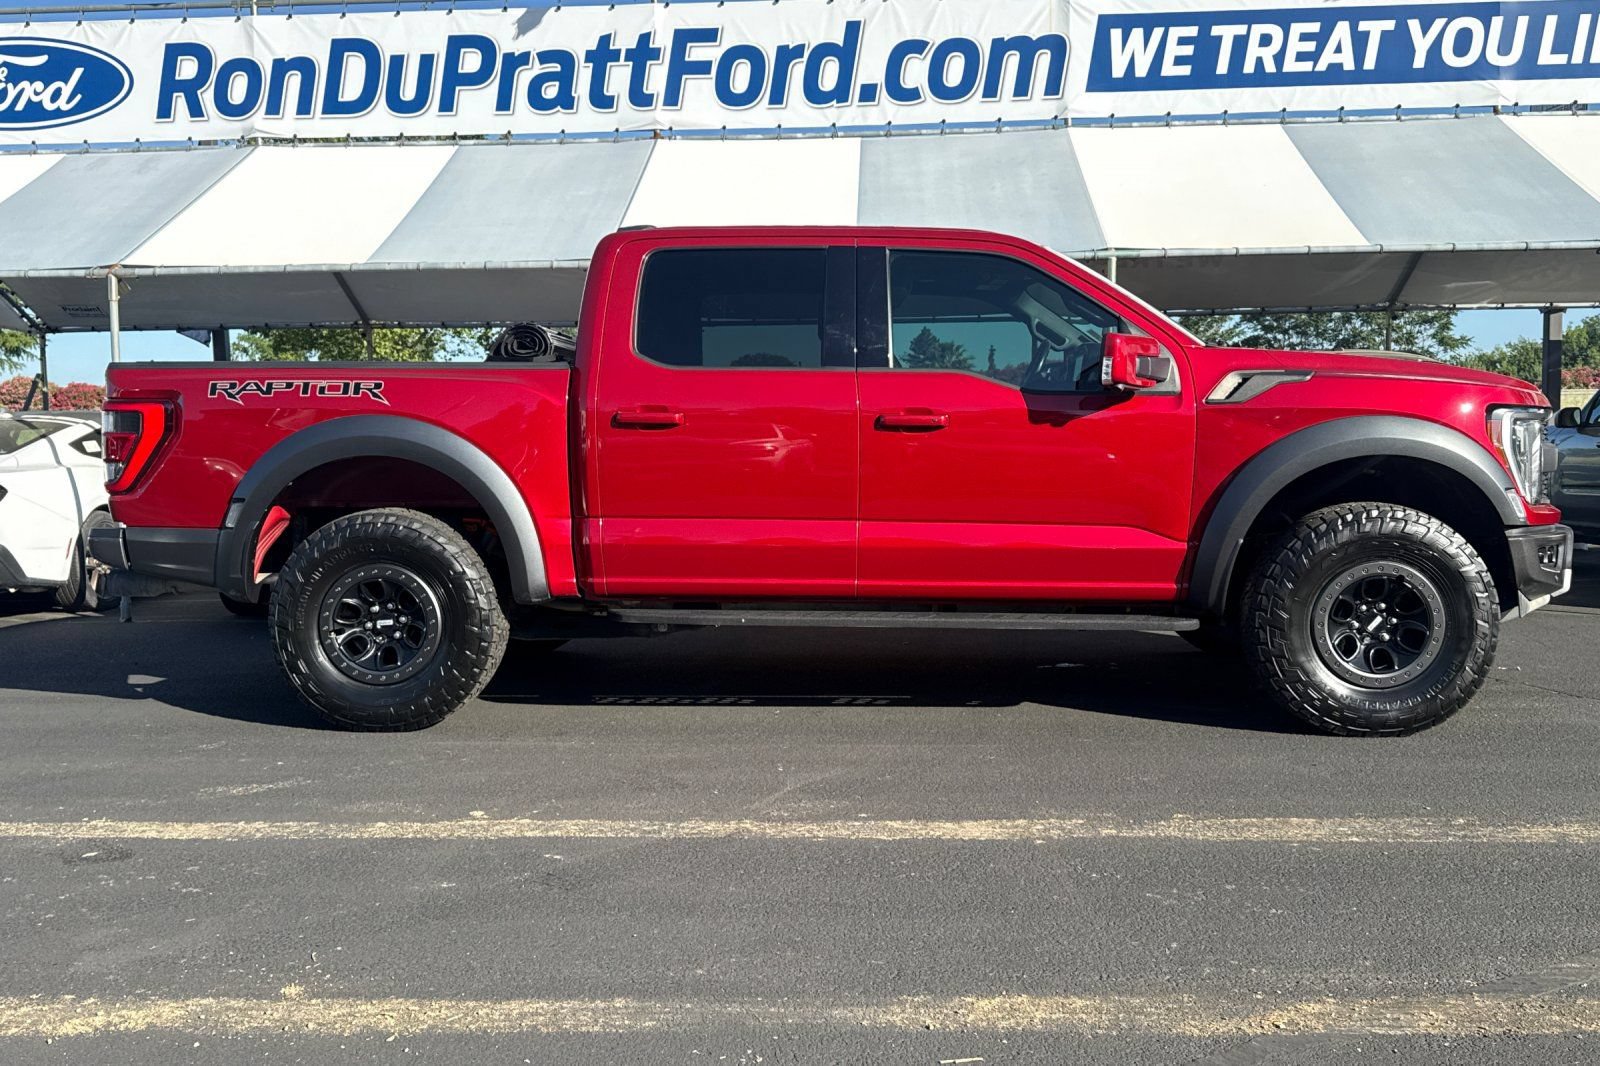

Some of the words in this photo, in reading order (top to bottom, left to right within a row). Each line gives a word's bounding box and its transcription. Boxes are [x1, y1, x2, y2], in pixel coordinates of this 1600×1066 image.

[155, 20, 1067, 121] RonDuPrattFord.com
[1109, 26, 1198, 79] WE
[1210, 20, 1395, 75] TREAT
[1410, 16, 1529, 68] YOU
[0, 54, 84, 111] ord
[208, 380, 391, 406] RAPTOR
